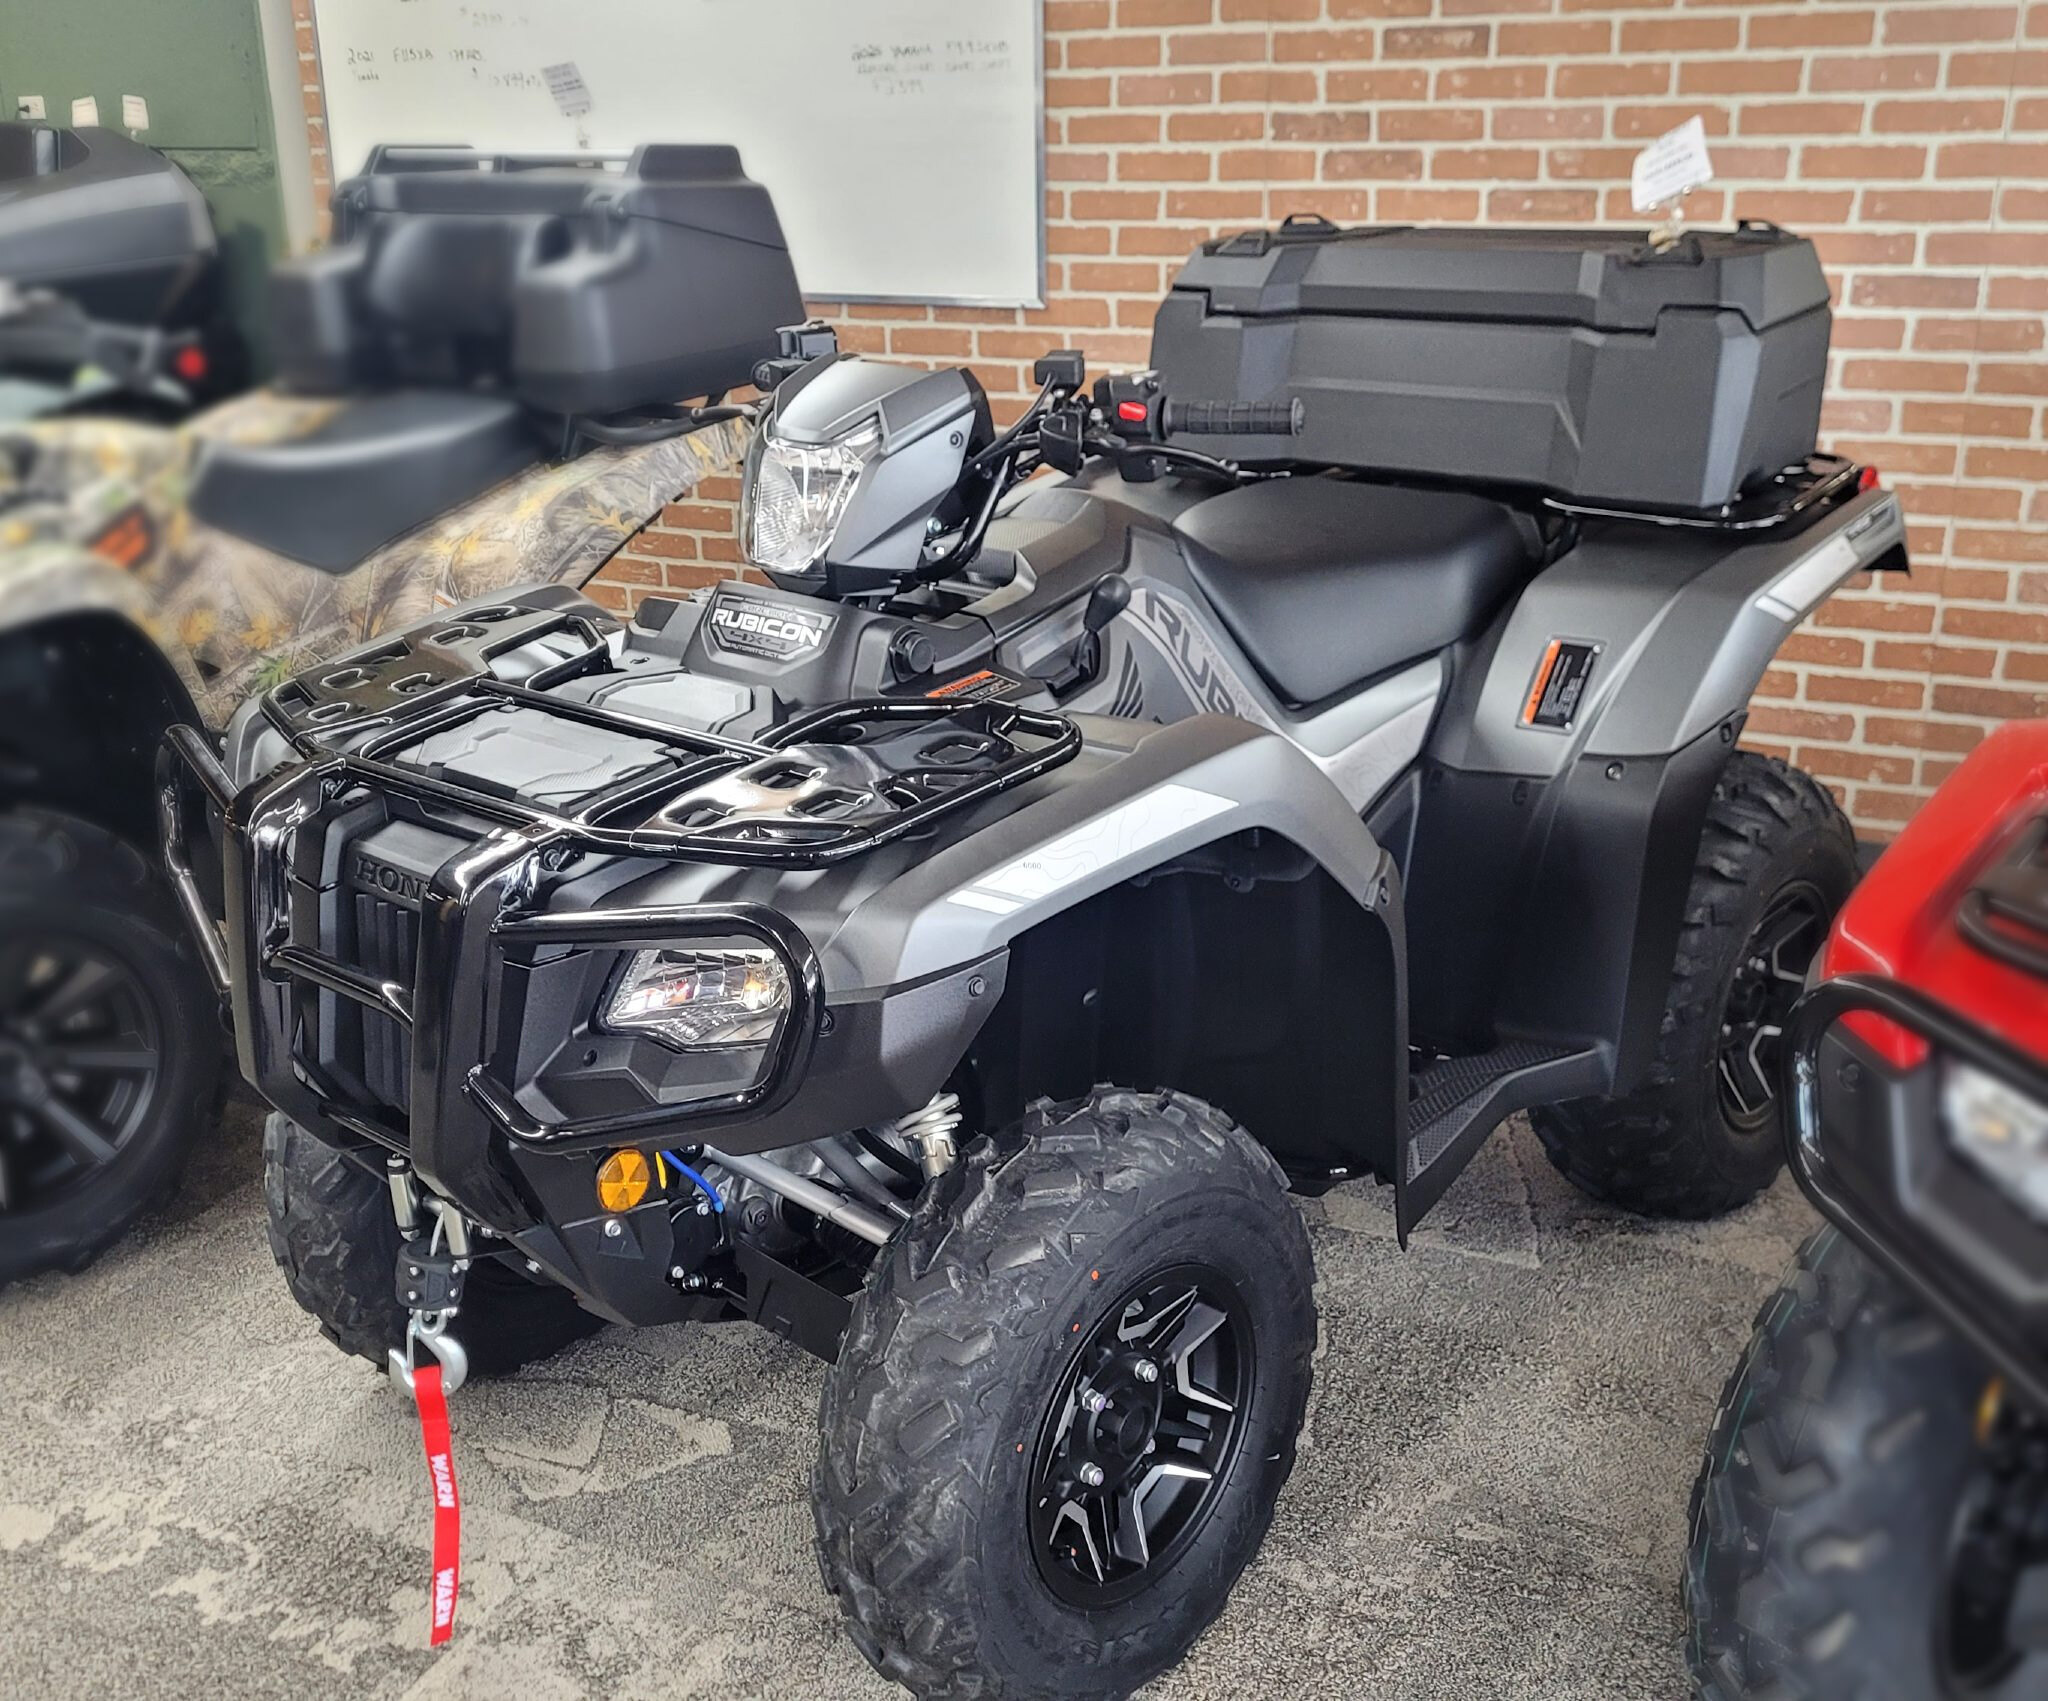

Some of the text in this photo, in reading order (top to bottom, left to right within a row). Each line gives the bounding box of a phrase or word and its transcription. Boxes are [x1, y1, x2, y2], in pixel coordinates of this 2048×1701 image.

[711, 608, 823, 646] RUBICON
[430, 1453, 455, 1508] WARN
[435, 1567, 455, 1628] WARN
